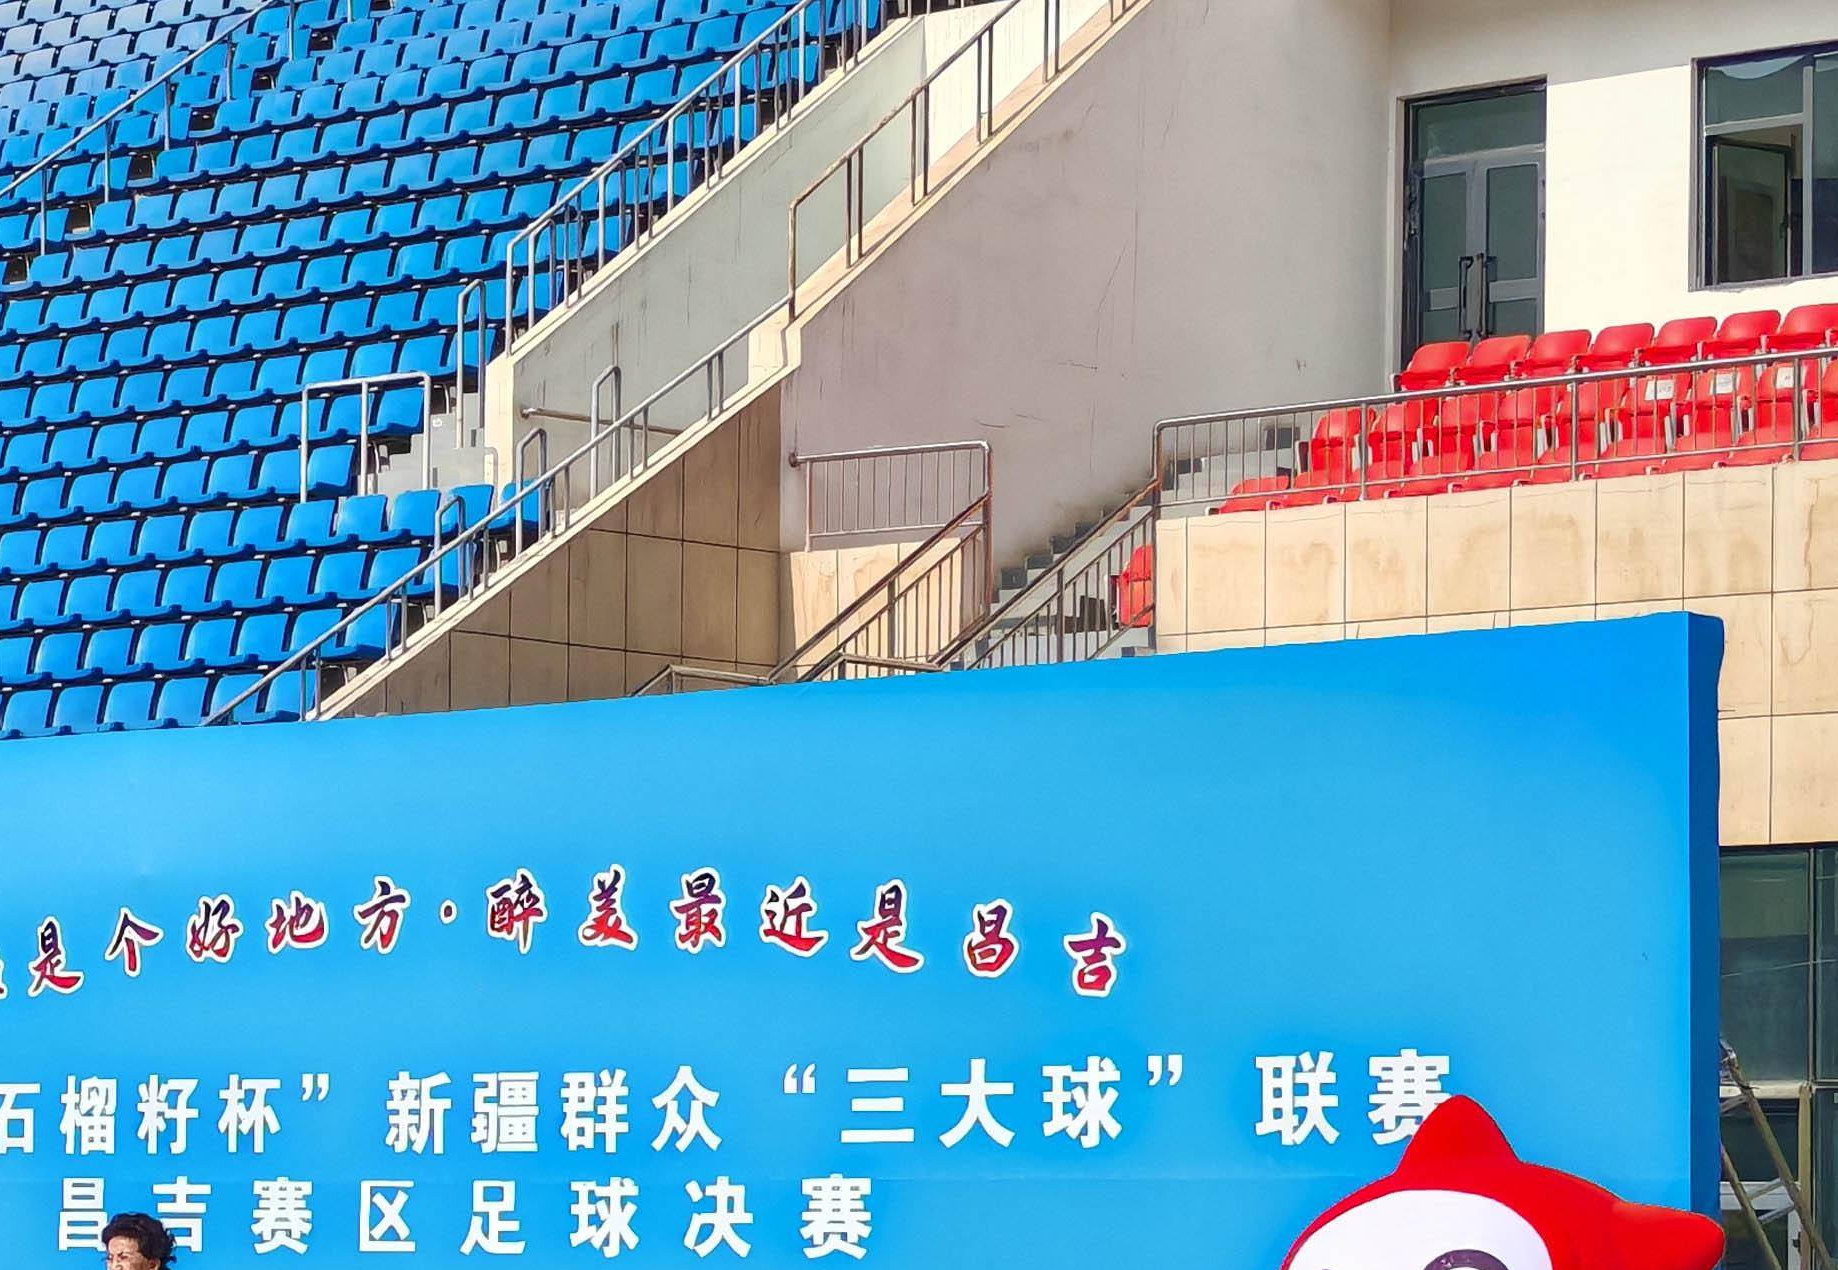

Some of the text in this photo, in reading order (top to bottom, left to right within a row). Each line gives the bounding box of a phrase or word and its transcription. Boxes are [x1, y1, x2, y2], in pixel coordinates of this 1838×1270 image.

[58, 1174, 873, 1259] 昌吉赛区足球决赛
